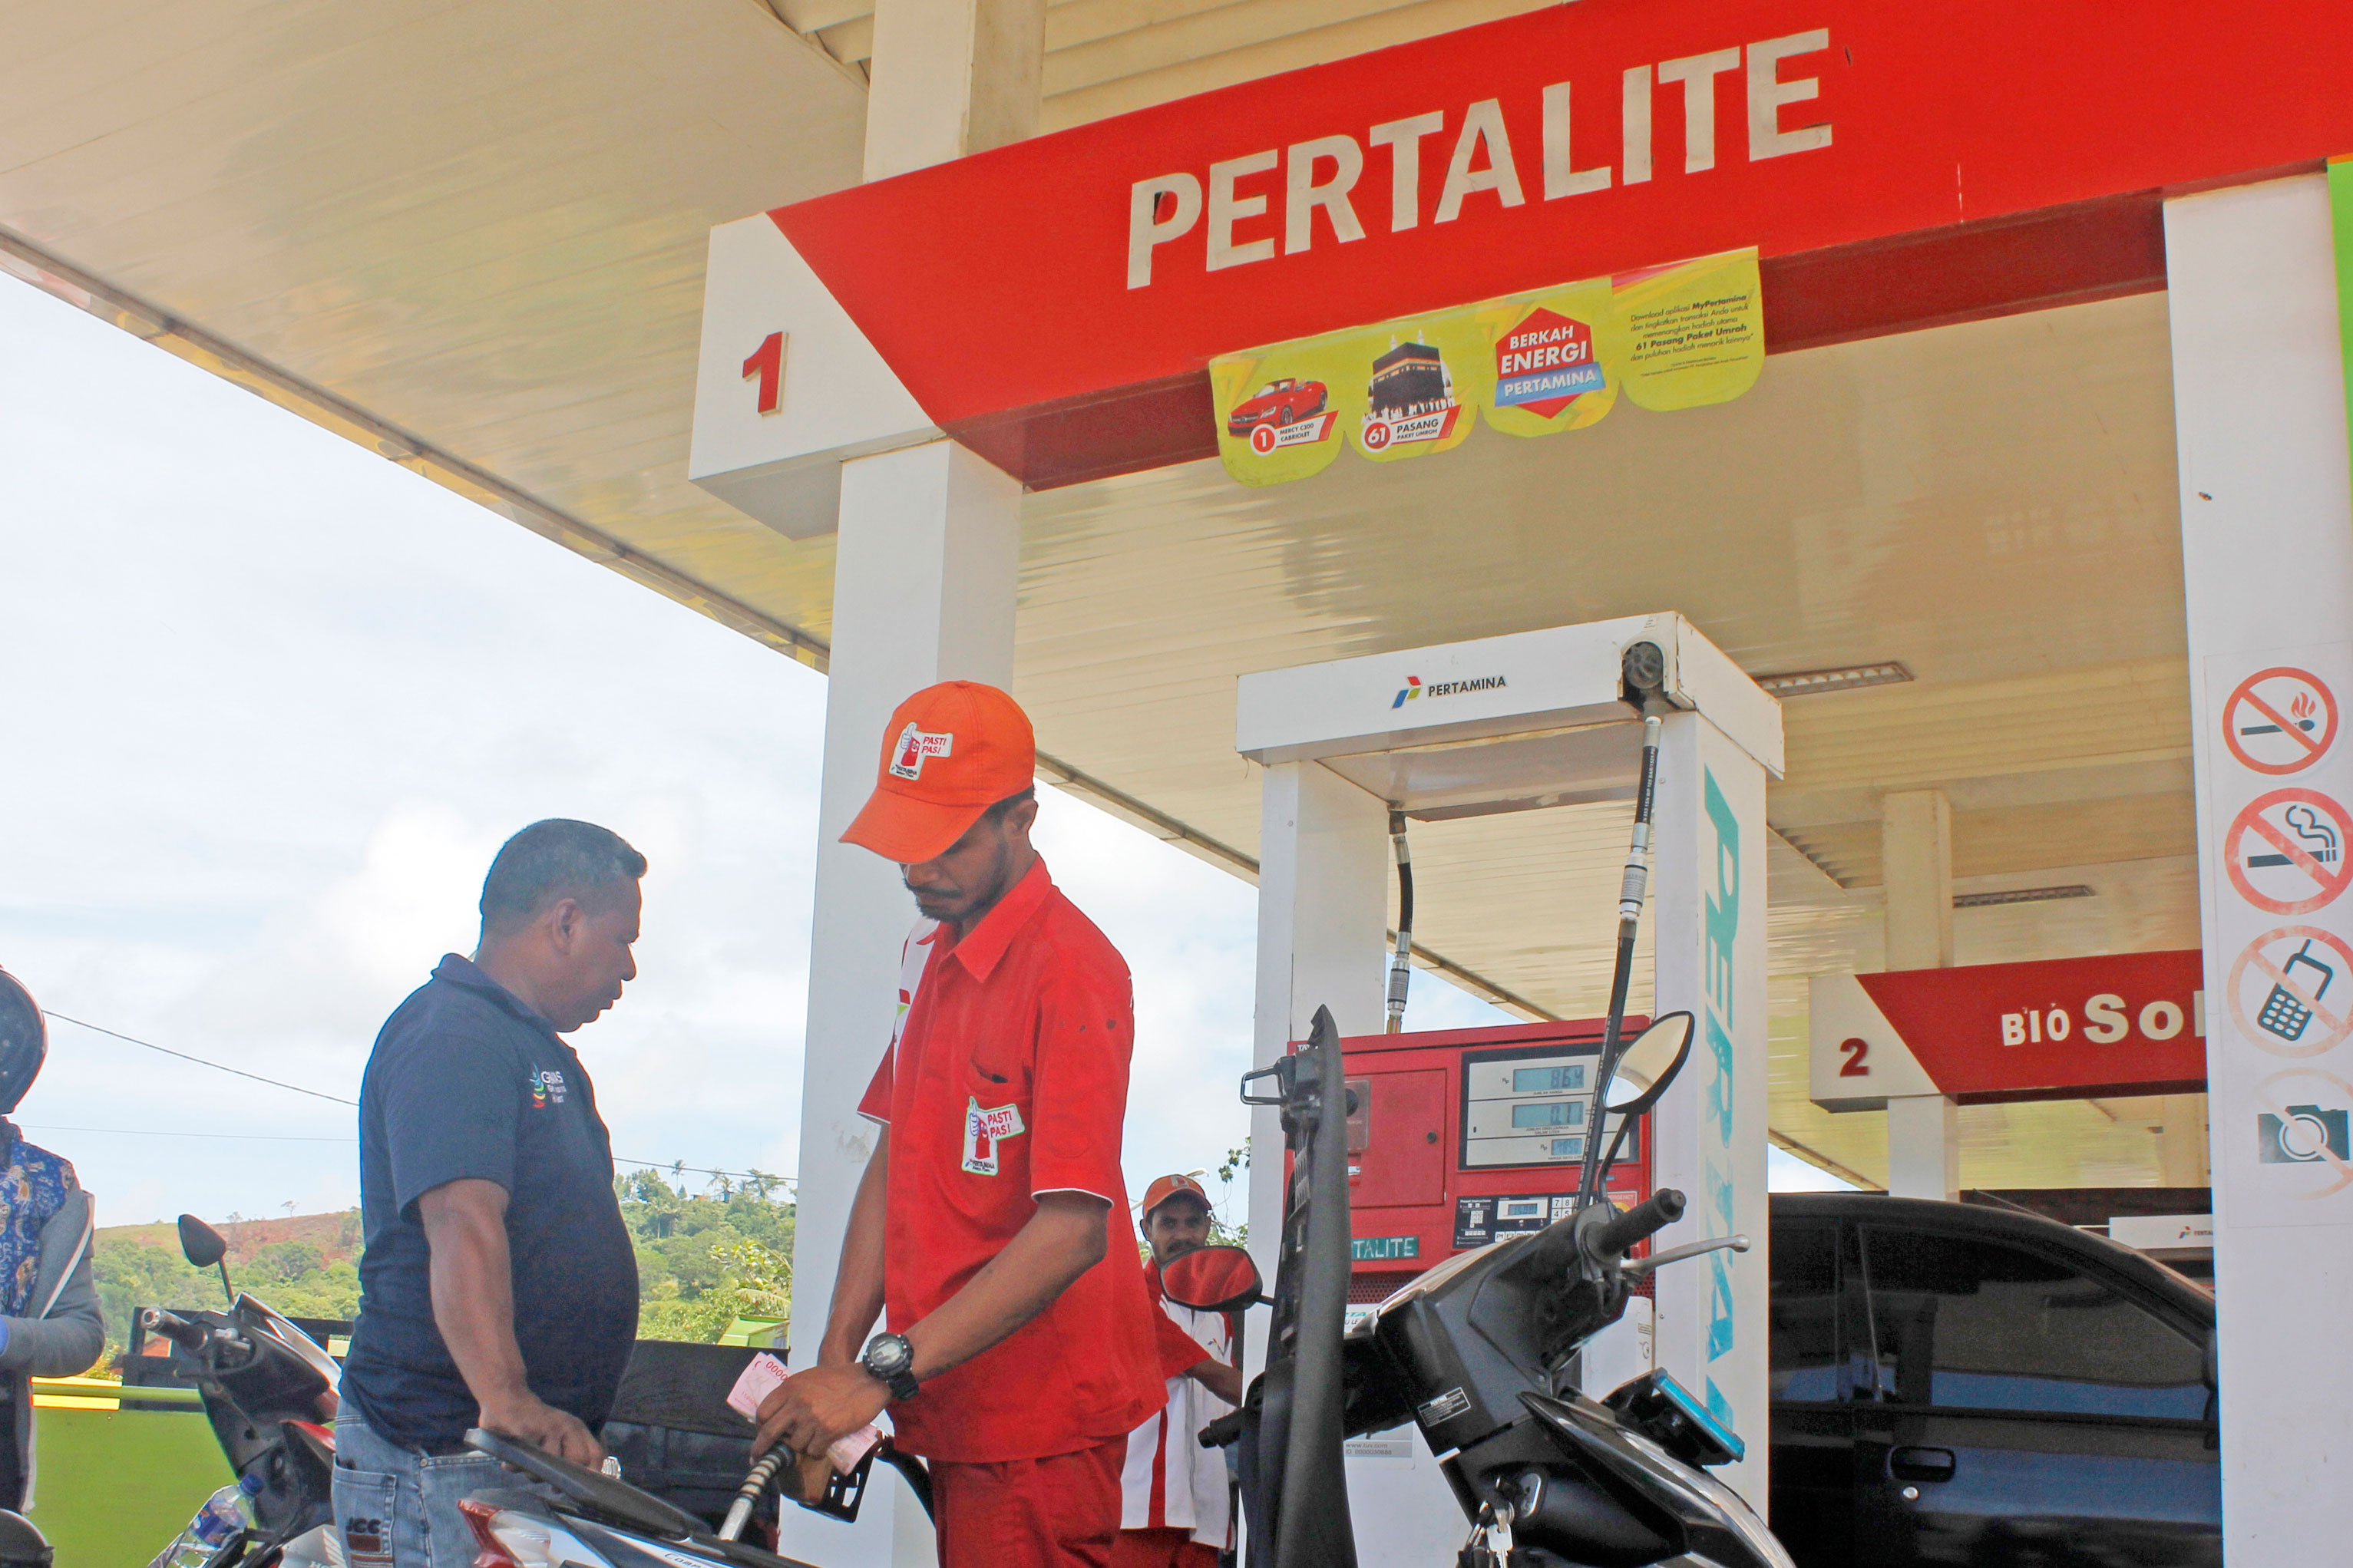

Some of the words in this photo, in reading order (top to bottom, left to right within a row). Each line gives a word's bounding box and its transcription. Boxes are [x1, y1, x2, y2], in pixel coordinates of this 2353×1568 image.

[1127, 28, 1833, 291] PERTALITE
[1631, 309, 1664, 322] Download
[1692, 295, 1747, 311] MyPertamina
[1509, 325, 1574, 350] BERKAH
[1635, 342, 1647, 351] 61
[1651, 336, 1684, 348] Pasang
[1687, 330, 1713, 342] Paket
[1716, 323, 1747, 336] Umroh
[1501, 341, 1587, 375] ENERGI
[742, 330, 786, 415] 1
[1504, 369, 1597, 398] PERTAMINA
[1260, 431, 1267, 448] 1
[1367, 426, 1386, 444] 61
[1397, 418, 1439, 434] PASANG
[1429, 675, 1506, 697] PERTAMINA
[1839, 1038, 1869, 1078] 2
[1353, 1236, 1415, 1259] TALITE
